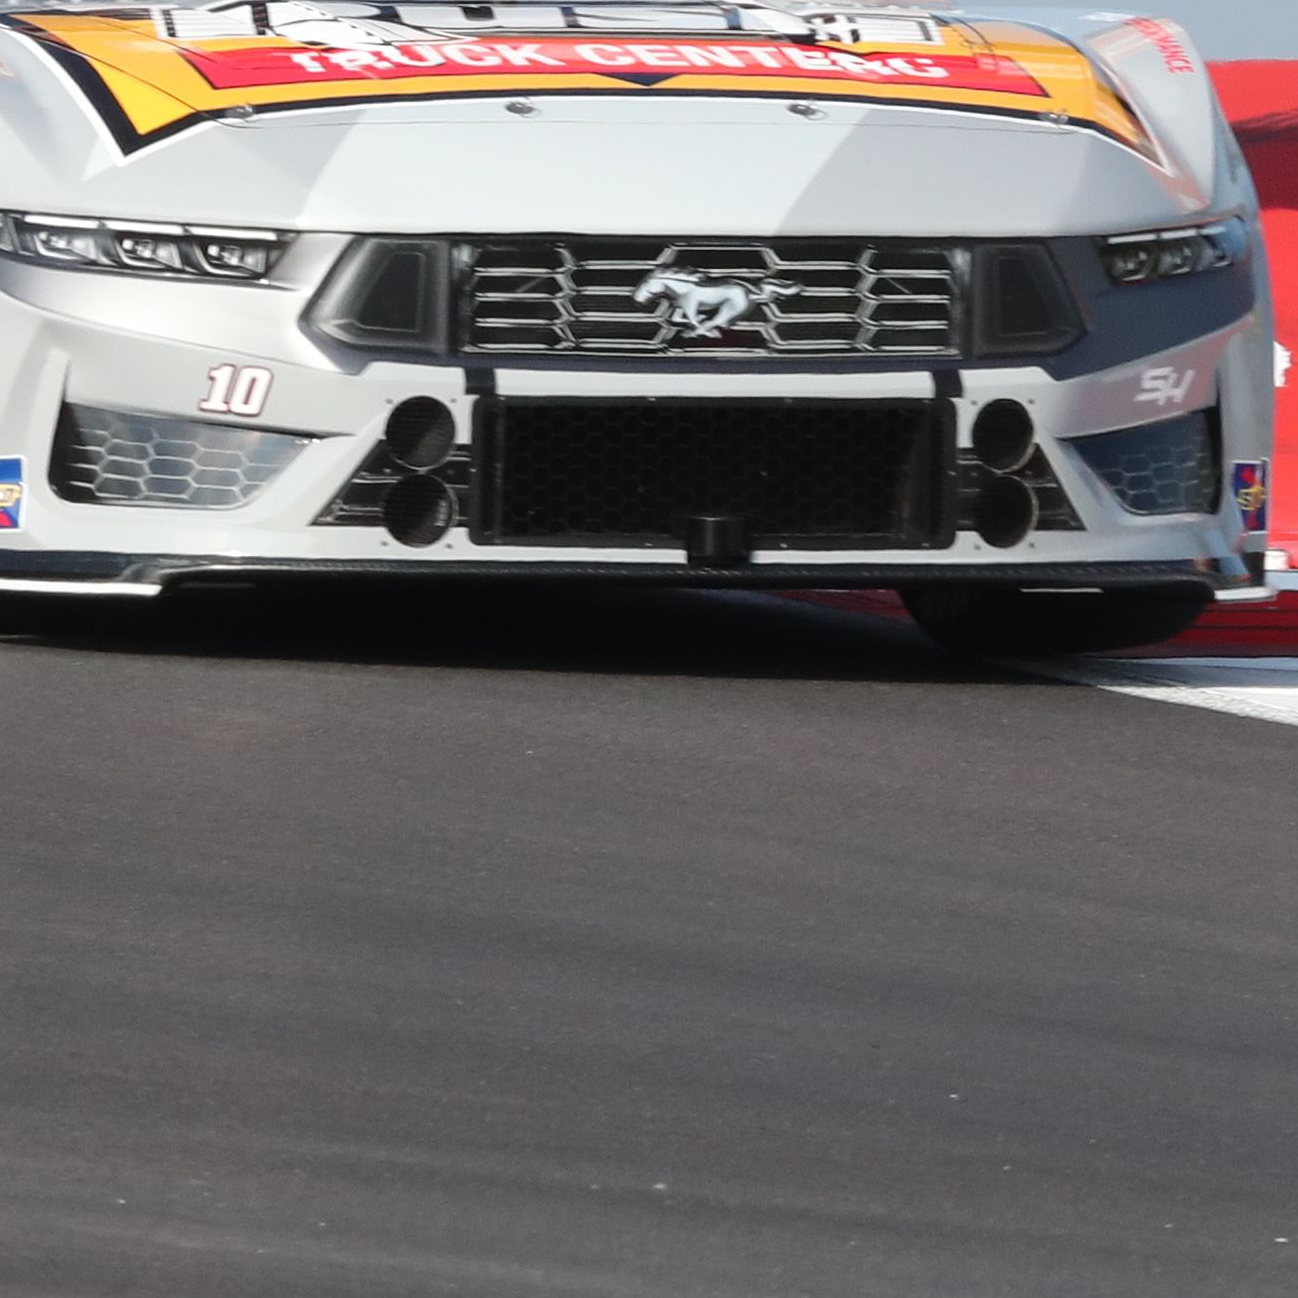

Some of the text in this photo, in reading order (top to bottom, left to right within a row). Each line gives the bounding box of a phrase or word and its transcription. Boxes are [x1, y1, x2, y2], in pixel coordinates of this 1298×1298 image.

[278, 42, 950, 80] TRUCK CENTERS
[198, 362, 274, 418] 10
